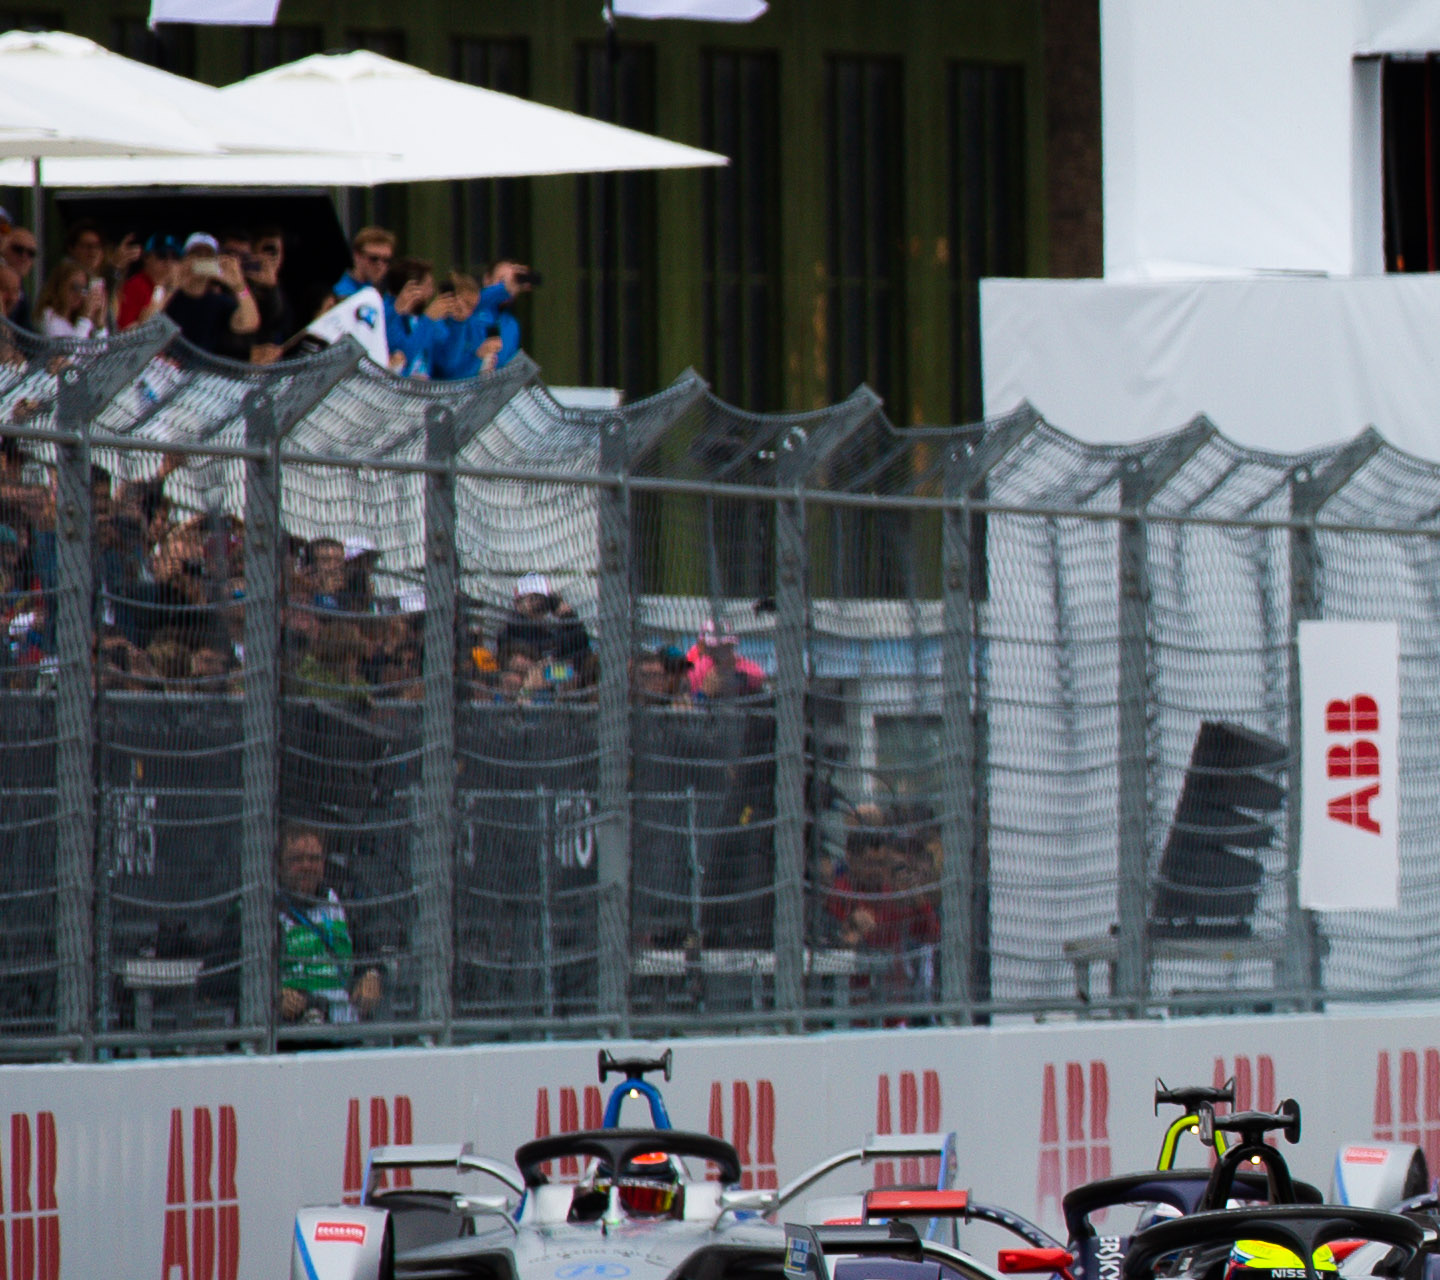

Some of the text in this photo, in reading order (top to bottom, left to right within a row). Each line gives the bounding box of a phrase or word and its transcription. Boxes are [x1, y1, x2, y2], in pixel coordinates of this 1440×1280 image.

[1324, 693, 1382, 836] ABB
[1038, 1060, 1111, 1222] ABB
[1271, 1269, 1324, 1280] NISSN
